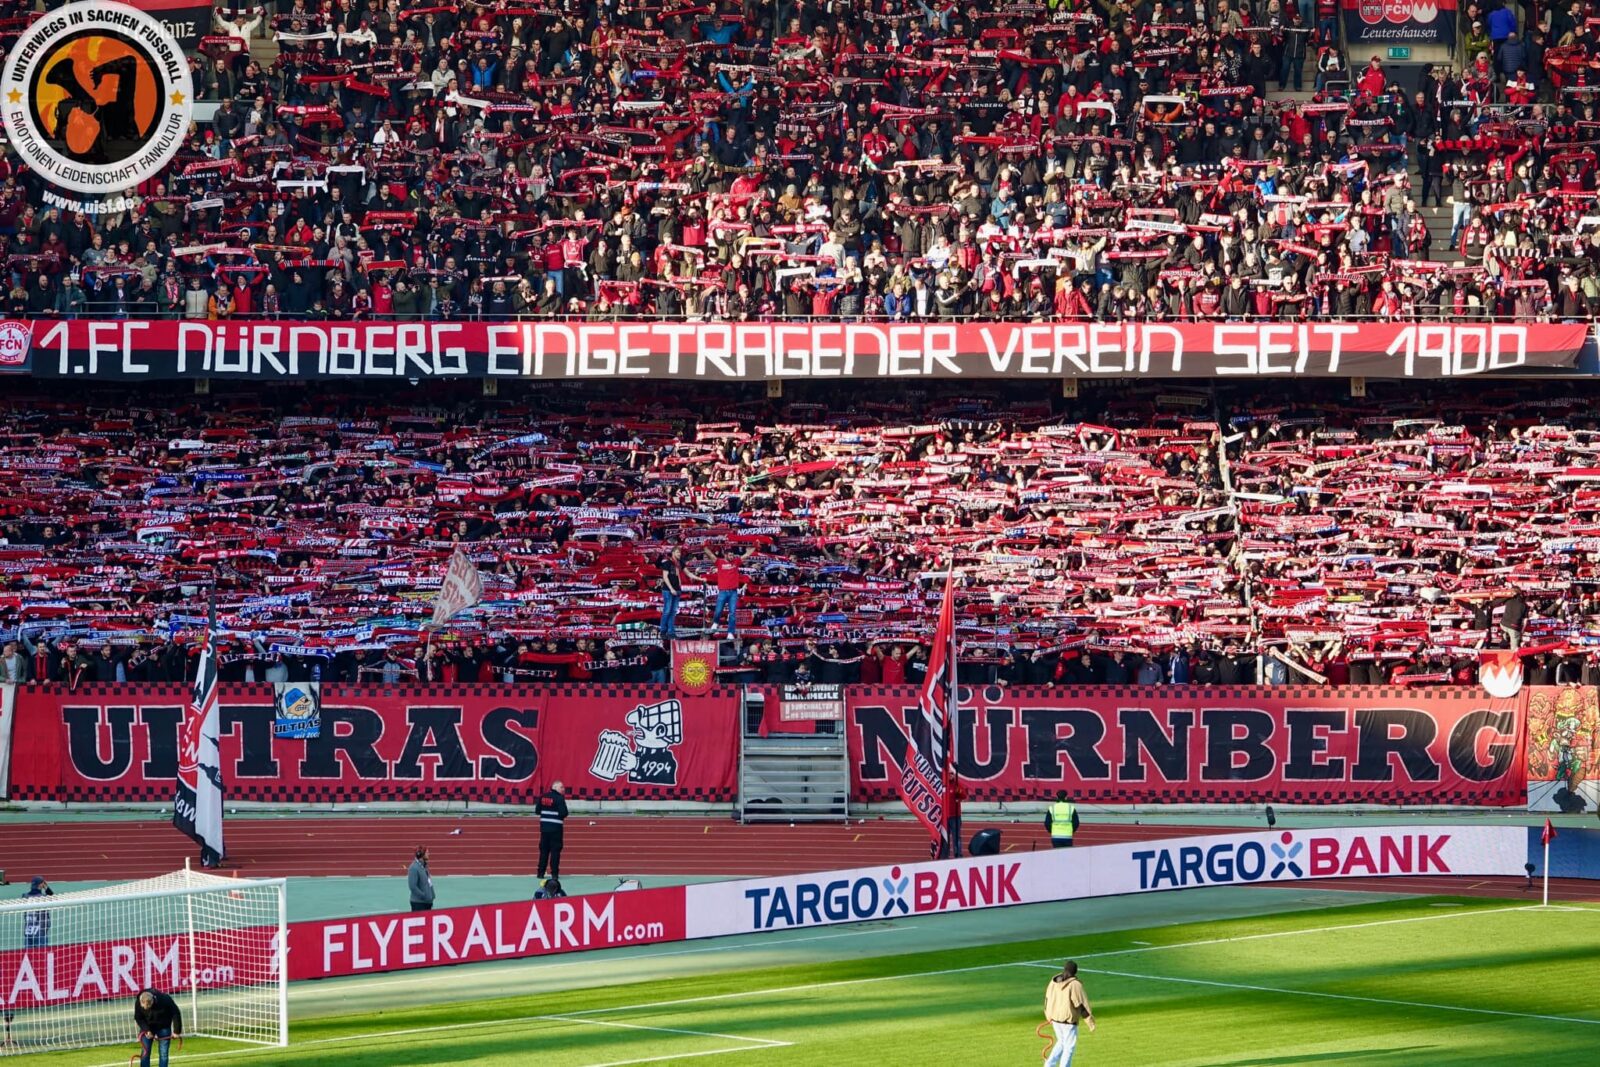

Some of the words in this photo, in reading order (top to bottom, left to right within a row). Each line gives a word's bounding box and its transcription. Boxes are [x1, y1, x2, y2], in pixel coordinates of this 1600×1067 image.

[1360, 26, 1437, 39] Leutershausen
[1385, 5, 1411, 16] FCN
[40, 322, 150, 374] 1.FC
[487, 324, 962, 376] EINGETRAGENER
[979, 324, 1183, 373] VEREIN
[1213, 325, 1359, 374] SEIT
[1386, 326, 1527, 376] 1900
[63, 704, 539, 782] ULTRAS
[274, 718, 321, 734] ULTRAS
[853, 686, 1517, 783] NÜRNBERG
[642, 760, 672, 776] 1994
[1131, 841, 1266, 891] TARGO
[1309, 834, 1451, 876] BANK
[745, 877, 879, 930] TARGO
[914, 862, 1022, 912] BANK
[323, 895, 664, 972] FLYERALARM.com
[0, 937, 235, 1006] ALARM.com
